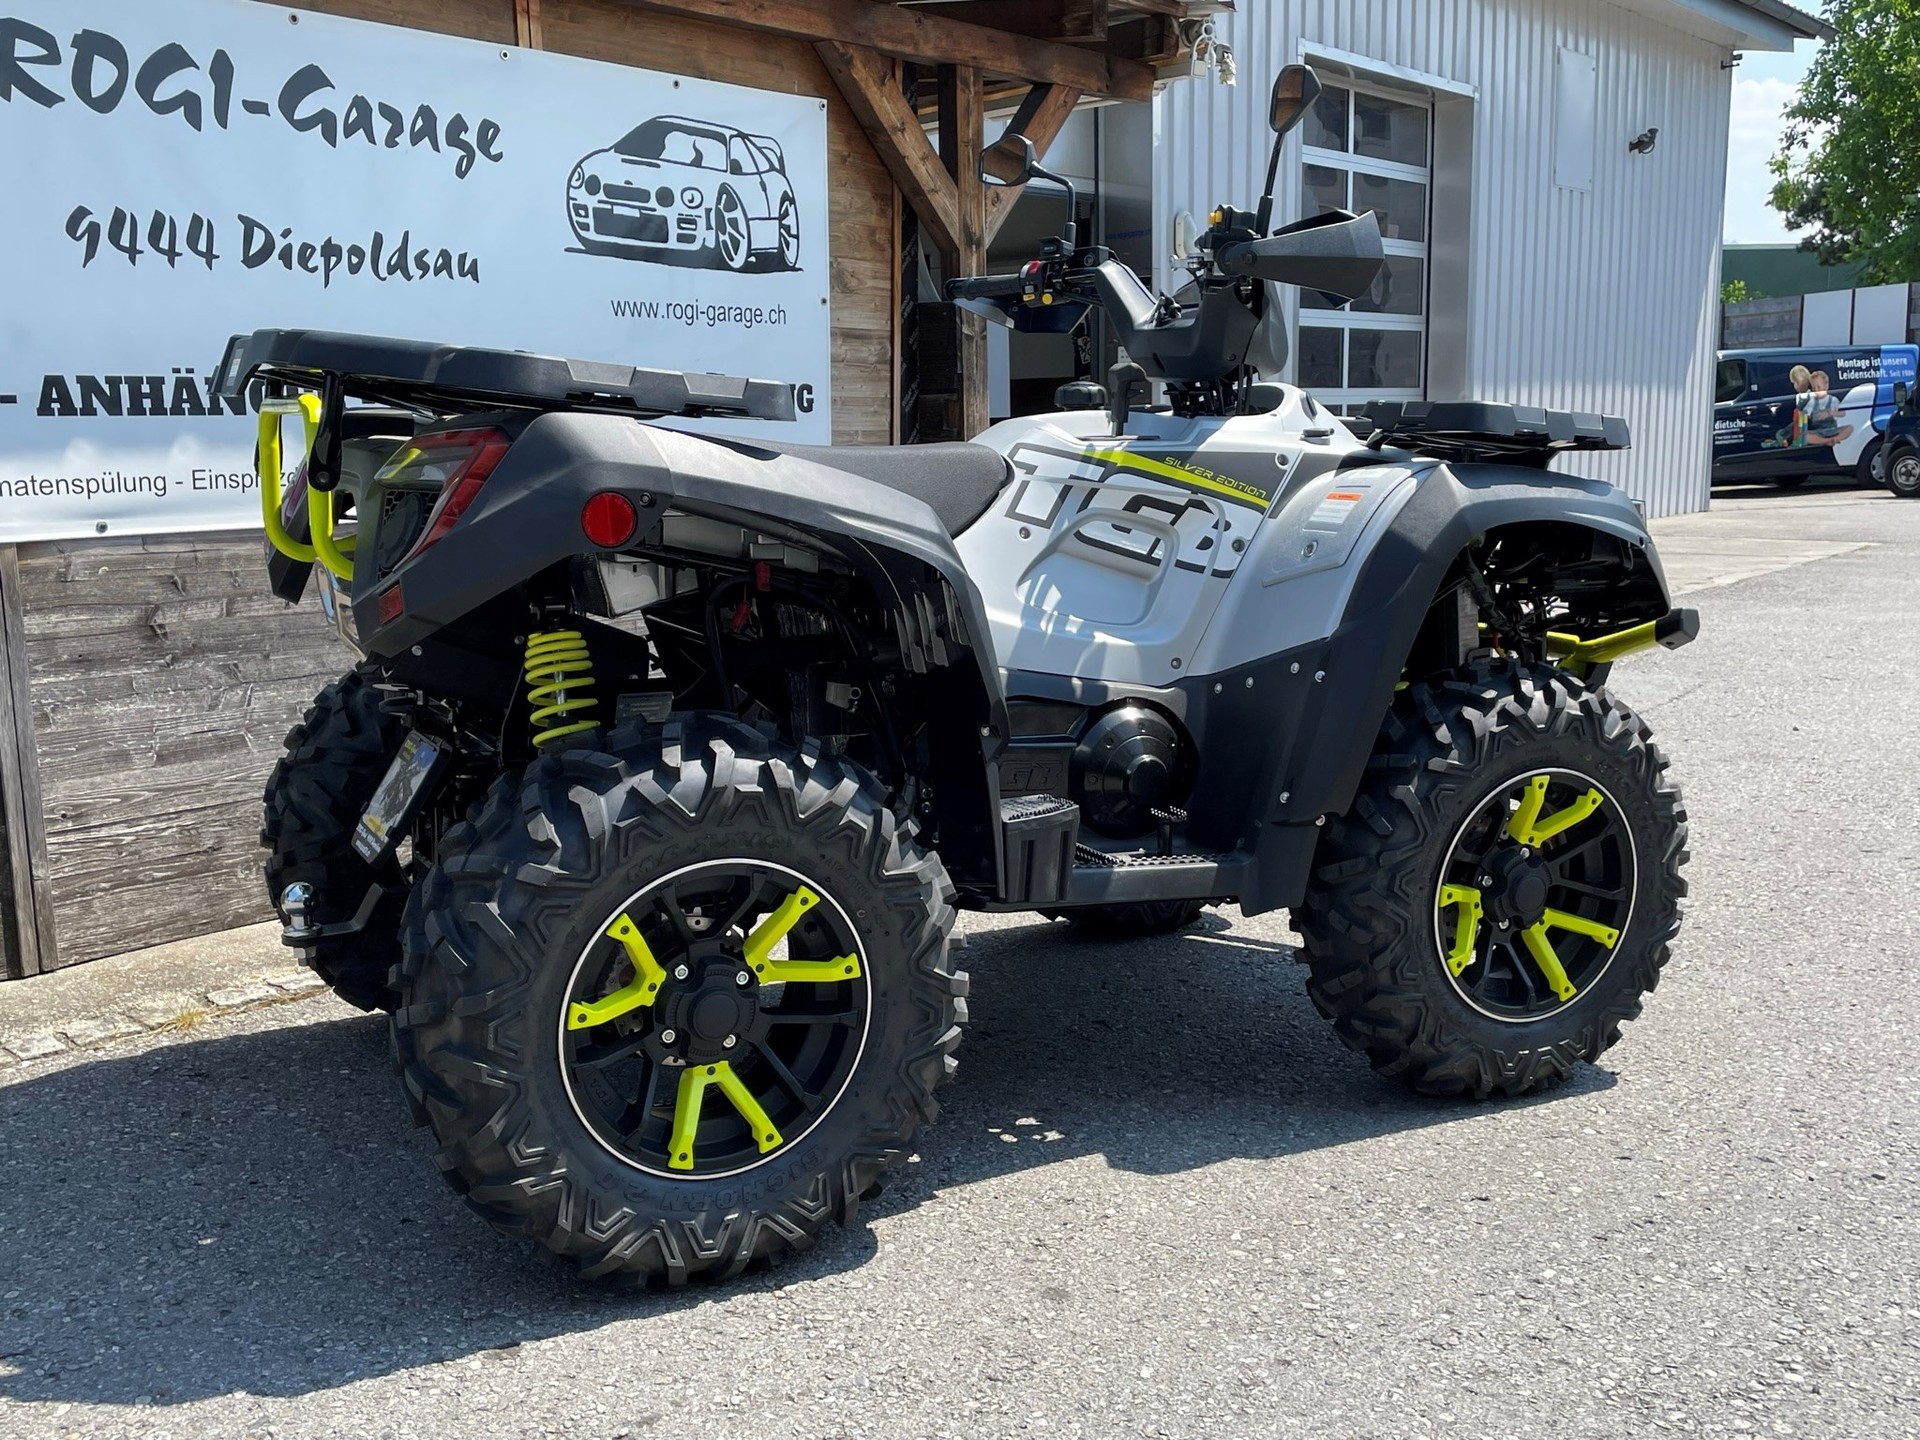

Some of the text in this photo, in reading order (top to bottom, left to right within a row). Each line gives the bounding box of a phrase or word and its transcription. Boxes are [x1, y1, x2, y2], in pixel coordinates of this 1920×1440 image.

[0, 17, 503, 179] ROGI-Garage
[65, 205, 480, 289] 9444 Diepoldsau
[611, 298, 787, 328] www.rogi-garage.ch
[1837, 356, 1908, 370] Montage ist unsere
[1838, 368, 1889, 380] Leidenschaft.
[1714, 418, 1746, 430] dietsche
[1163, 456, 1267, 499] SILVER EDITION
